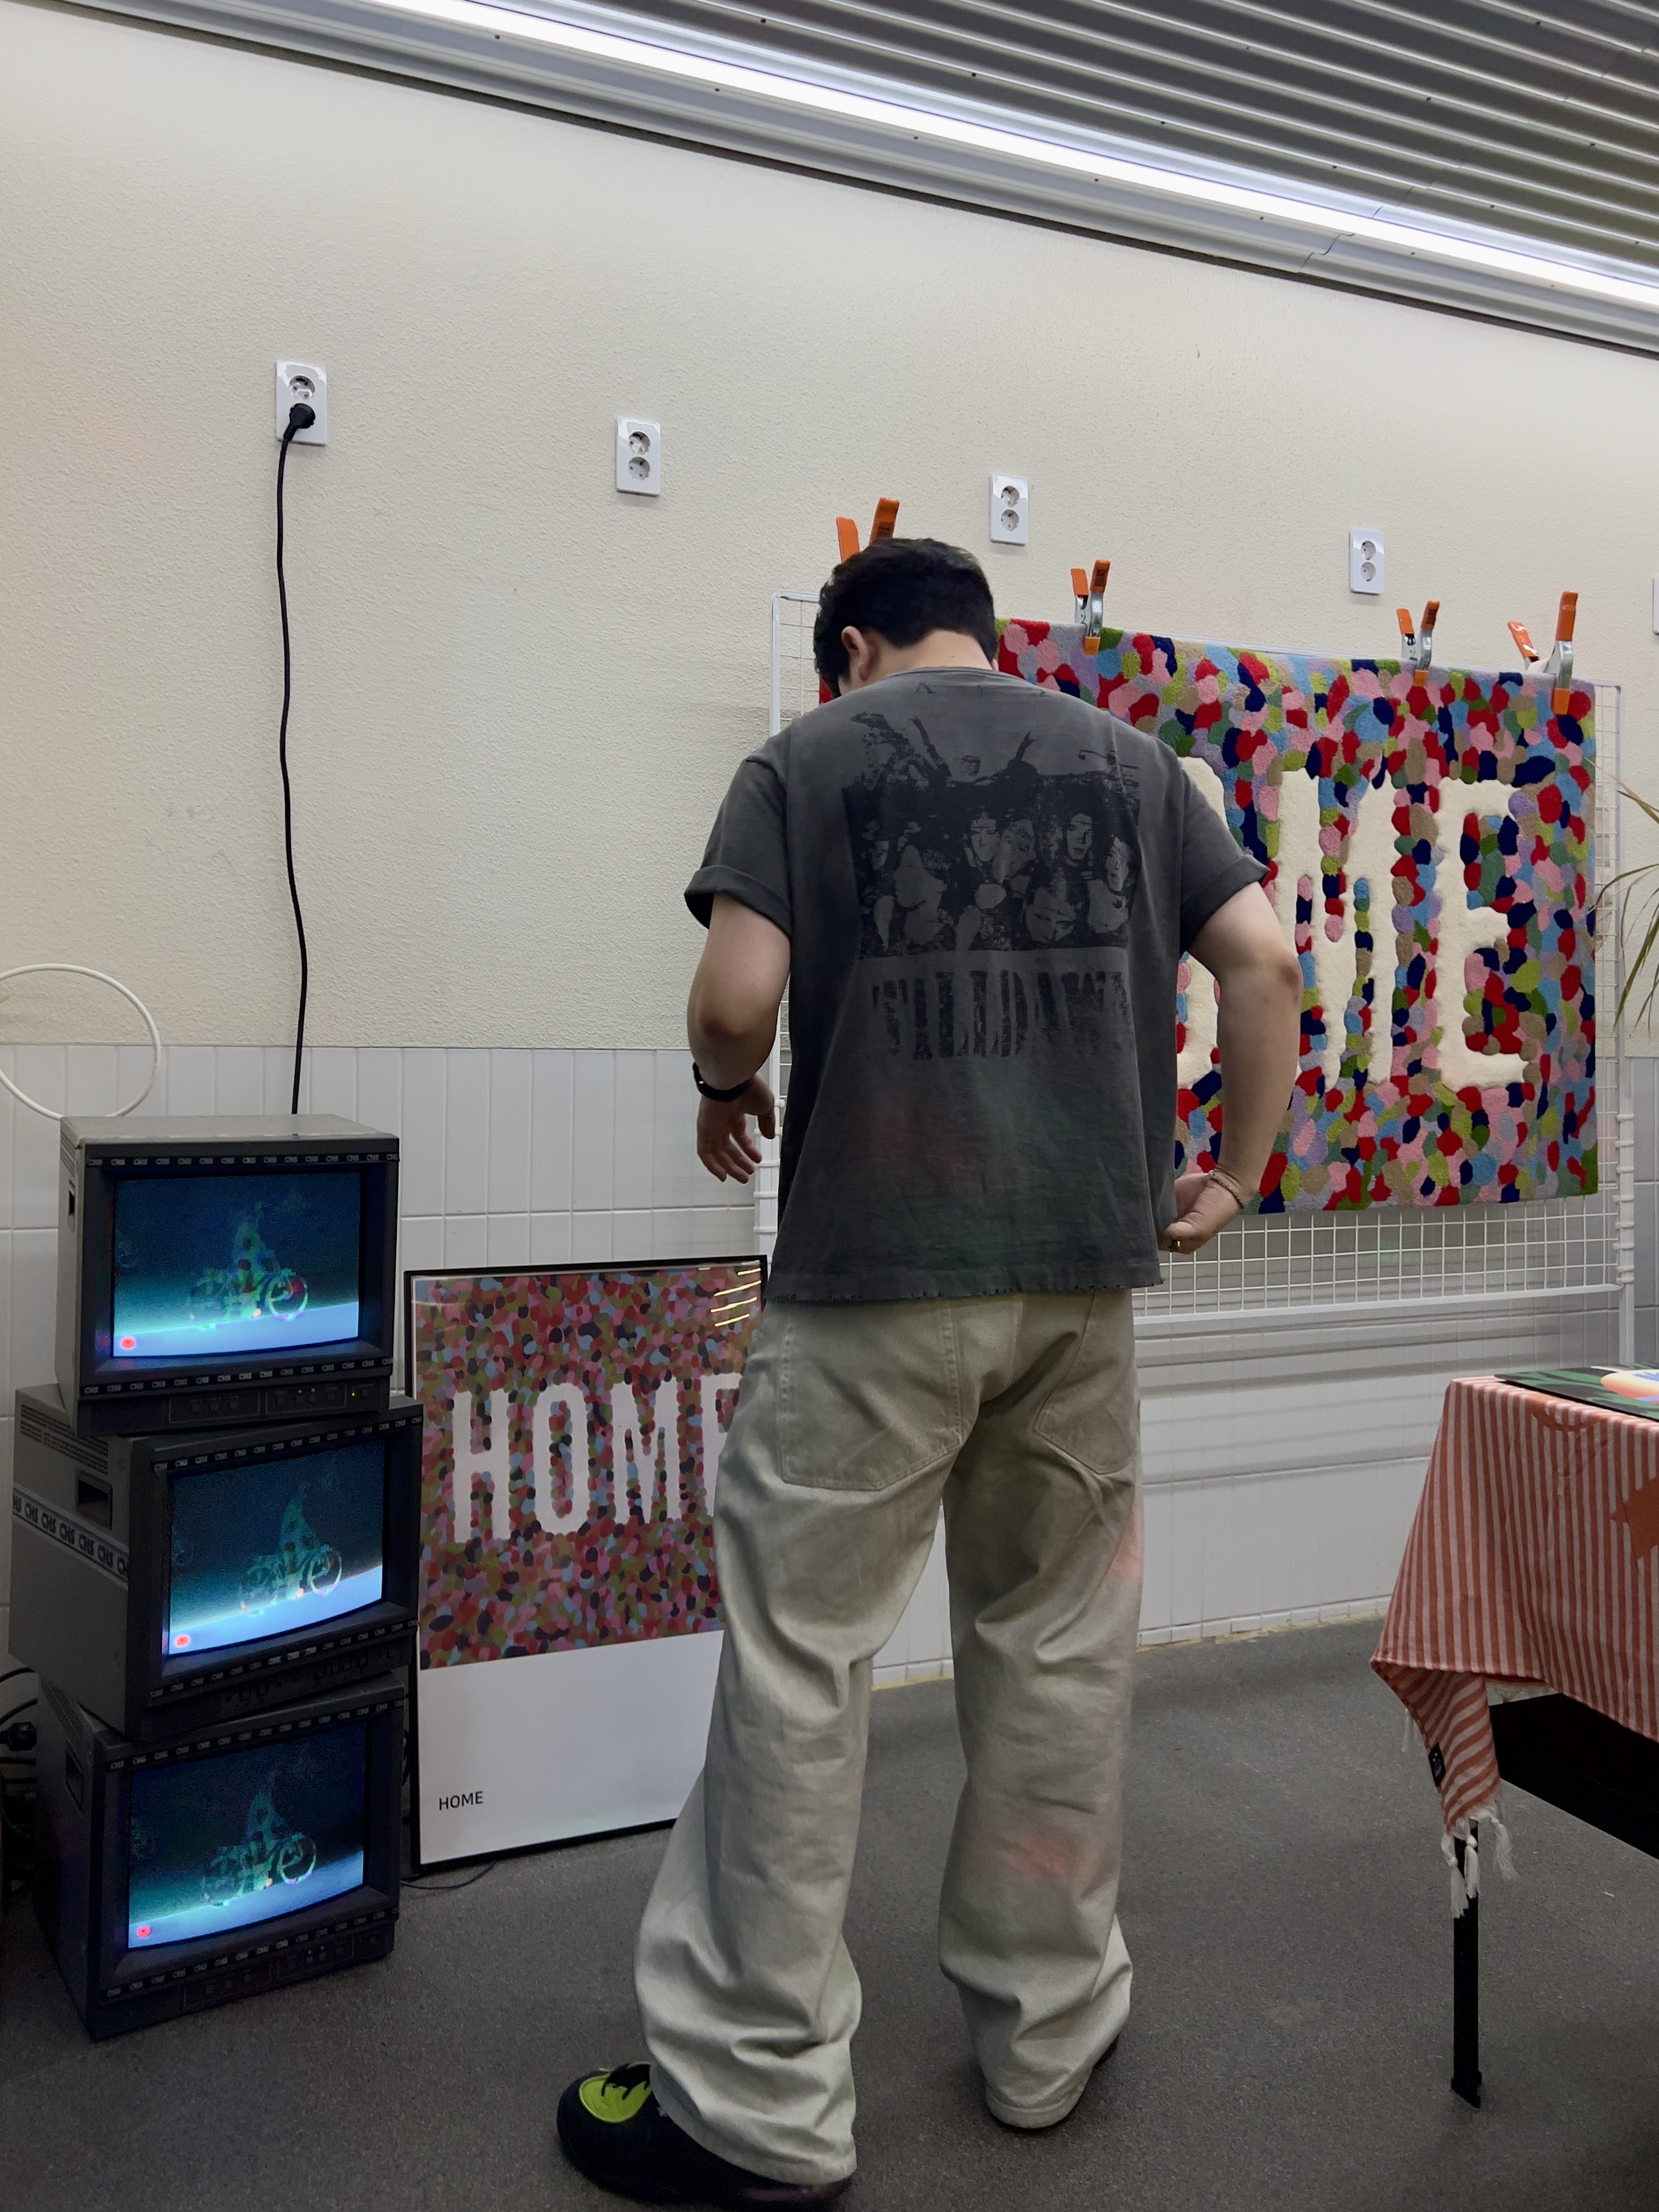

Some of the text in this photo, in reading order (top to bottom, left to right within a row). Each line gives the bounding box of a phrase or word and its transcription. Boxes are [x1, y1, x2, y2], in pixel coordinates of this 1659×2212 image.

[25, 1503, 38, 1523] CHS
[42, 1513, 56, 1533] CHS
[60, 1523, 74, 1544] CHS
[79, 1534, 95, 1555] CHS
[97, 1545, 113, 1567] CHS
[439, 1791, 483, 1811] HOME
